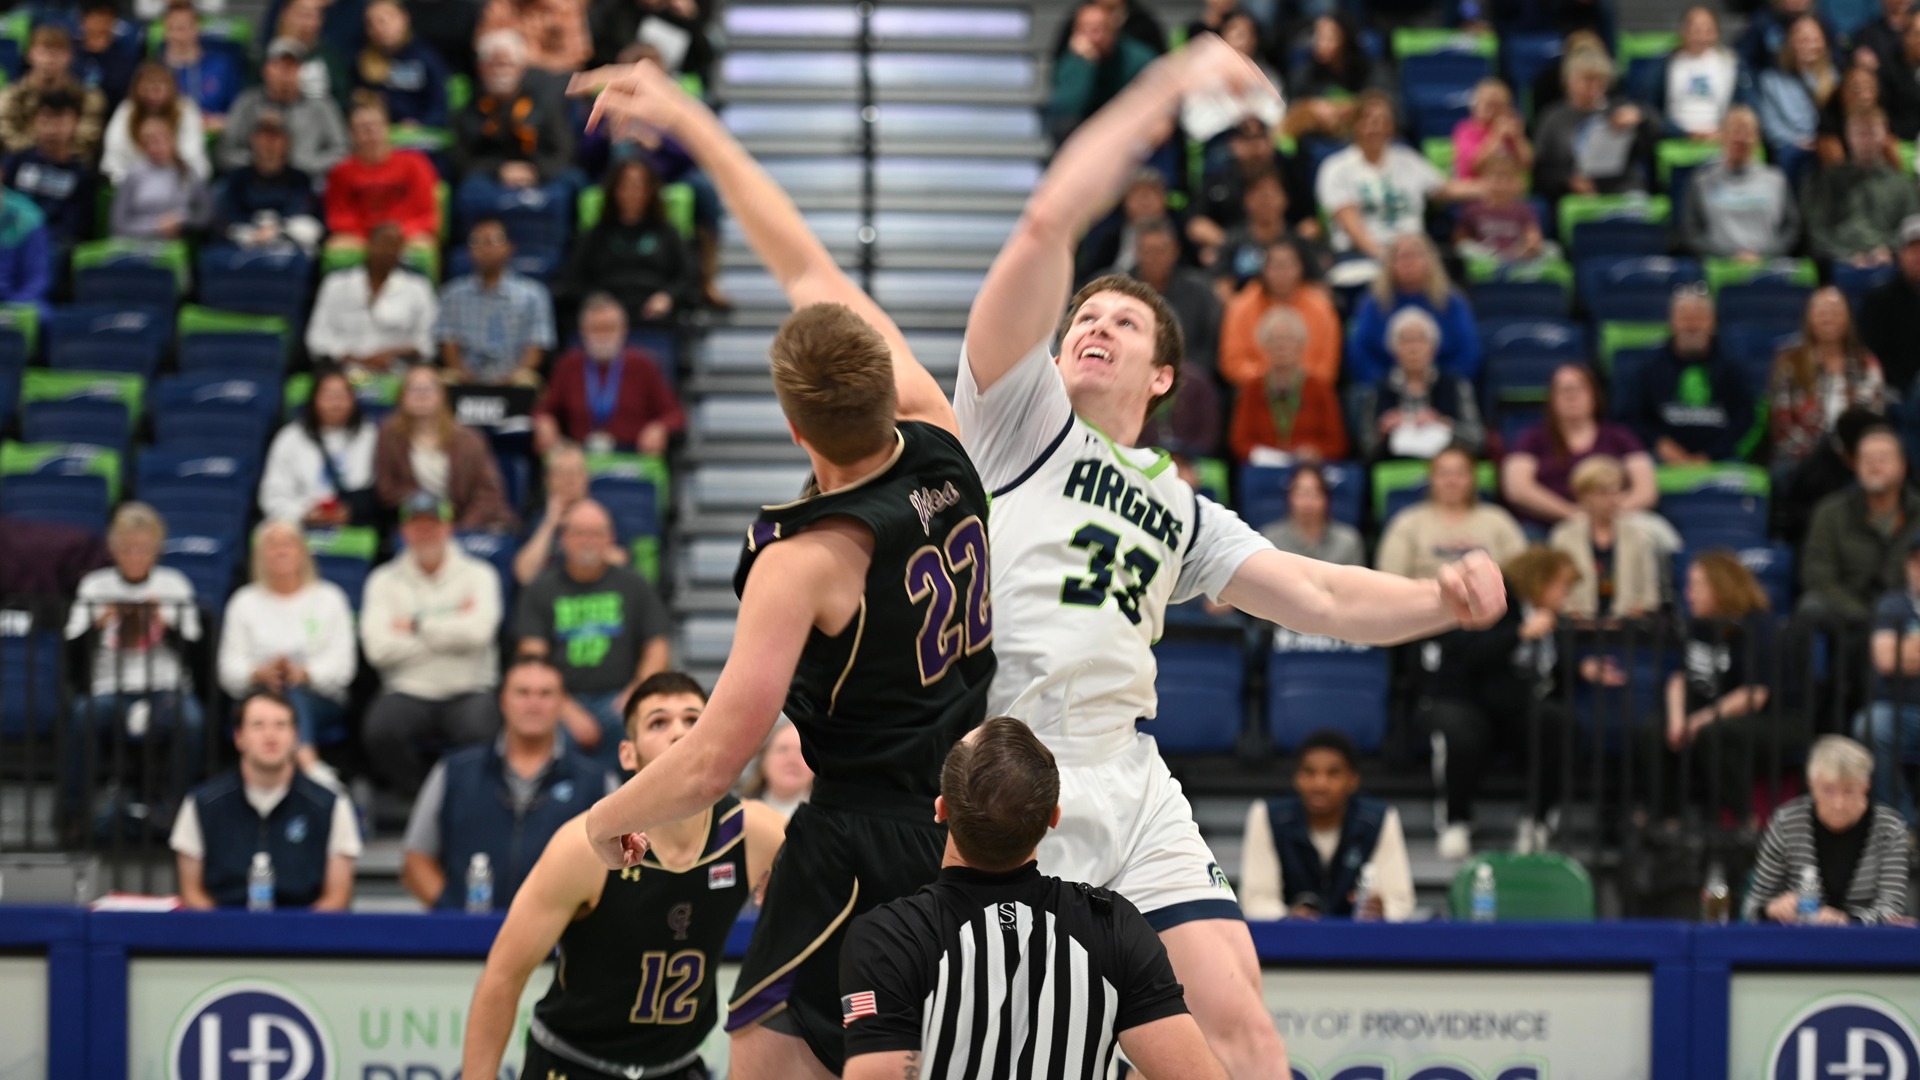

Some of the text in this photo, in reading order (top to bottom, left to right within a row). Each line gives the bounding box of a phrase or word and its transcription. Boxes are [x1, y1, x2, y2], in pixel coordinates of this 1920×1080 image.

[1062, 458, 1184, 553] ARGOS
[904, 514, 993, 688] 22
[1059, 519, 1163, 627] 33
[629, 948, 707, 1026] 12
[1360, 1006, 1549, 1043] PROVIDENCE
